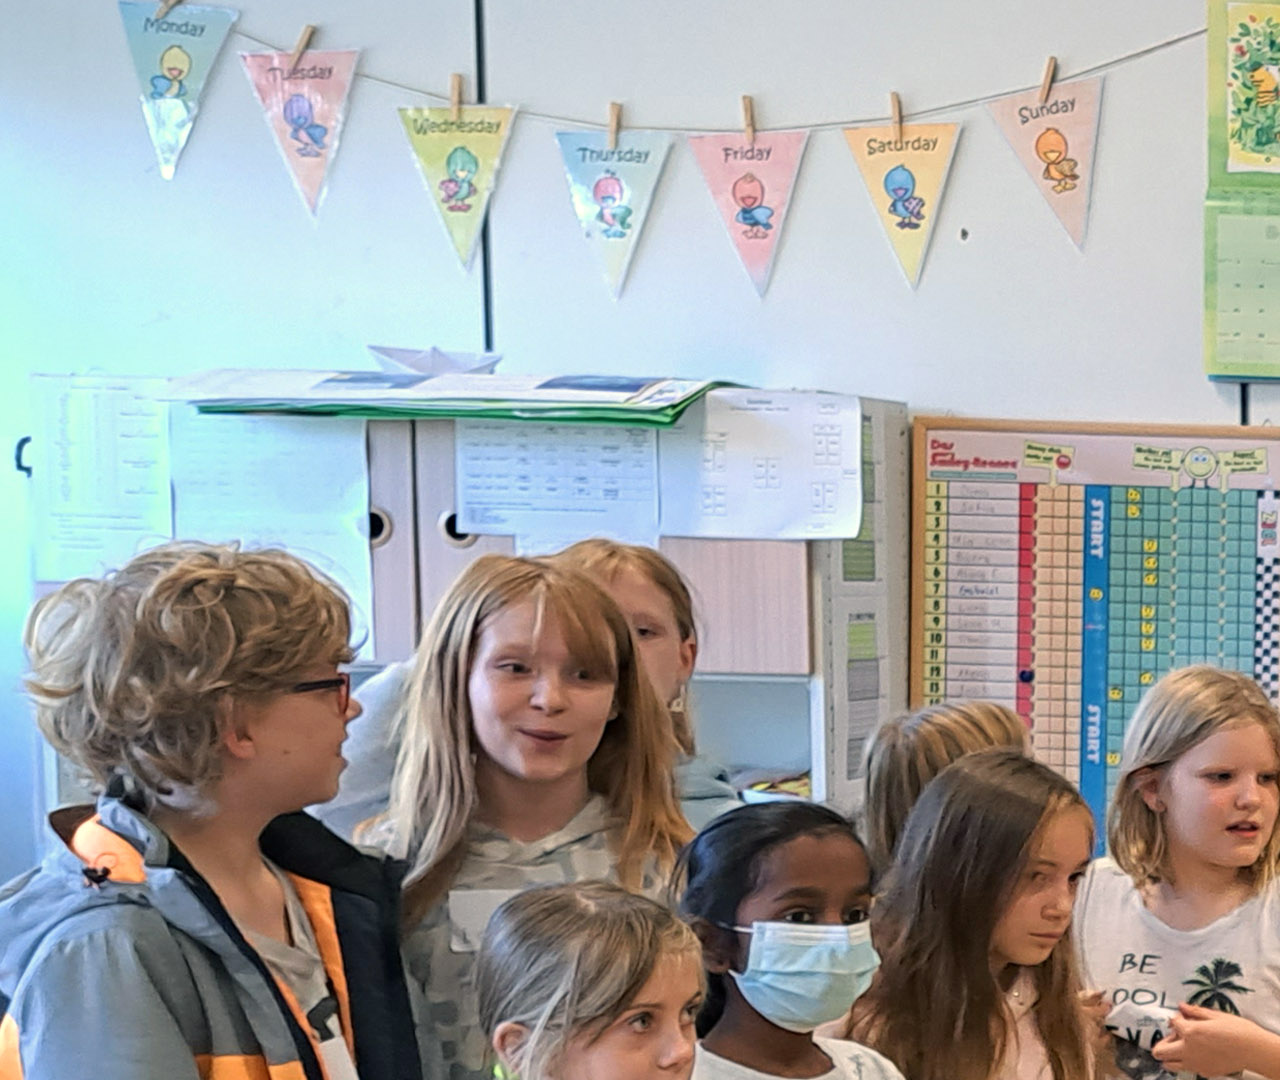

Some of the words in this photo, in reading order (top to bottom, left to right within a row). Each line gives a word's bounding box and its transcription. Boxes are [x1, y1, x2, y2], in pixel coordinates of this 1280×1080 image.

[144, 17, 206, 38] Monday
[268, 66, 334, 81] Tuesday
[1018, 97, 1077, 125] Sunday
[412, 118, 503, 136] Wednesday
[577, 147, 651, 165] Thursday
[721, 146, 773, 164] Friday
[866, 136, 939, 156] Saturday
[1089, 498, 1105, 559] START
[1086, 703, 1101, 765] START
[1119, 953, 1162, 974] BE
